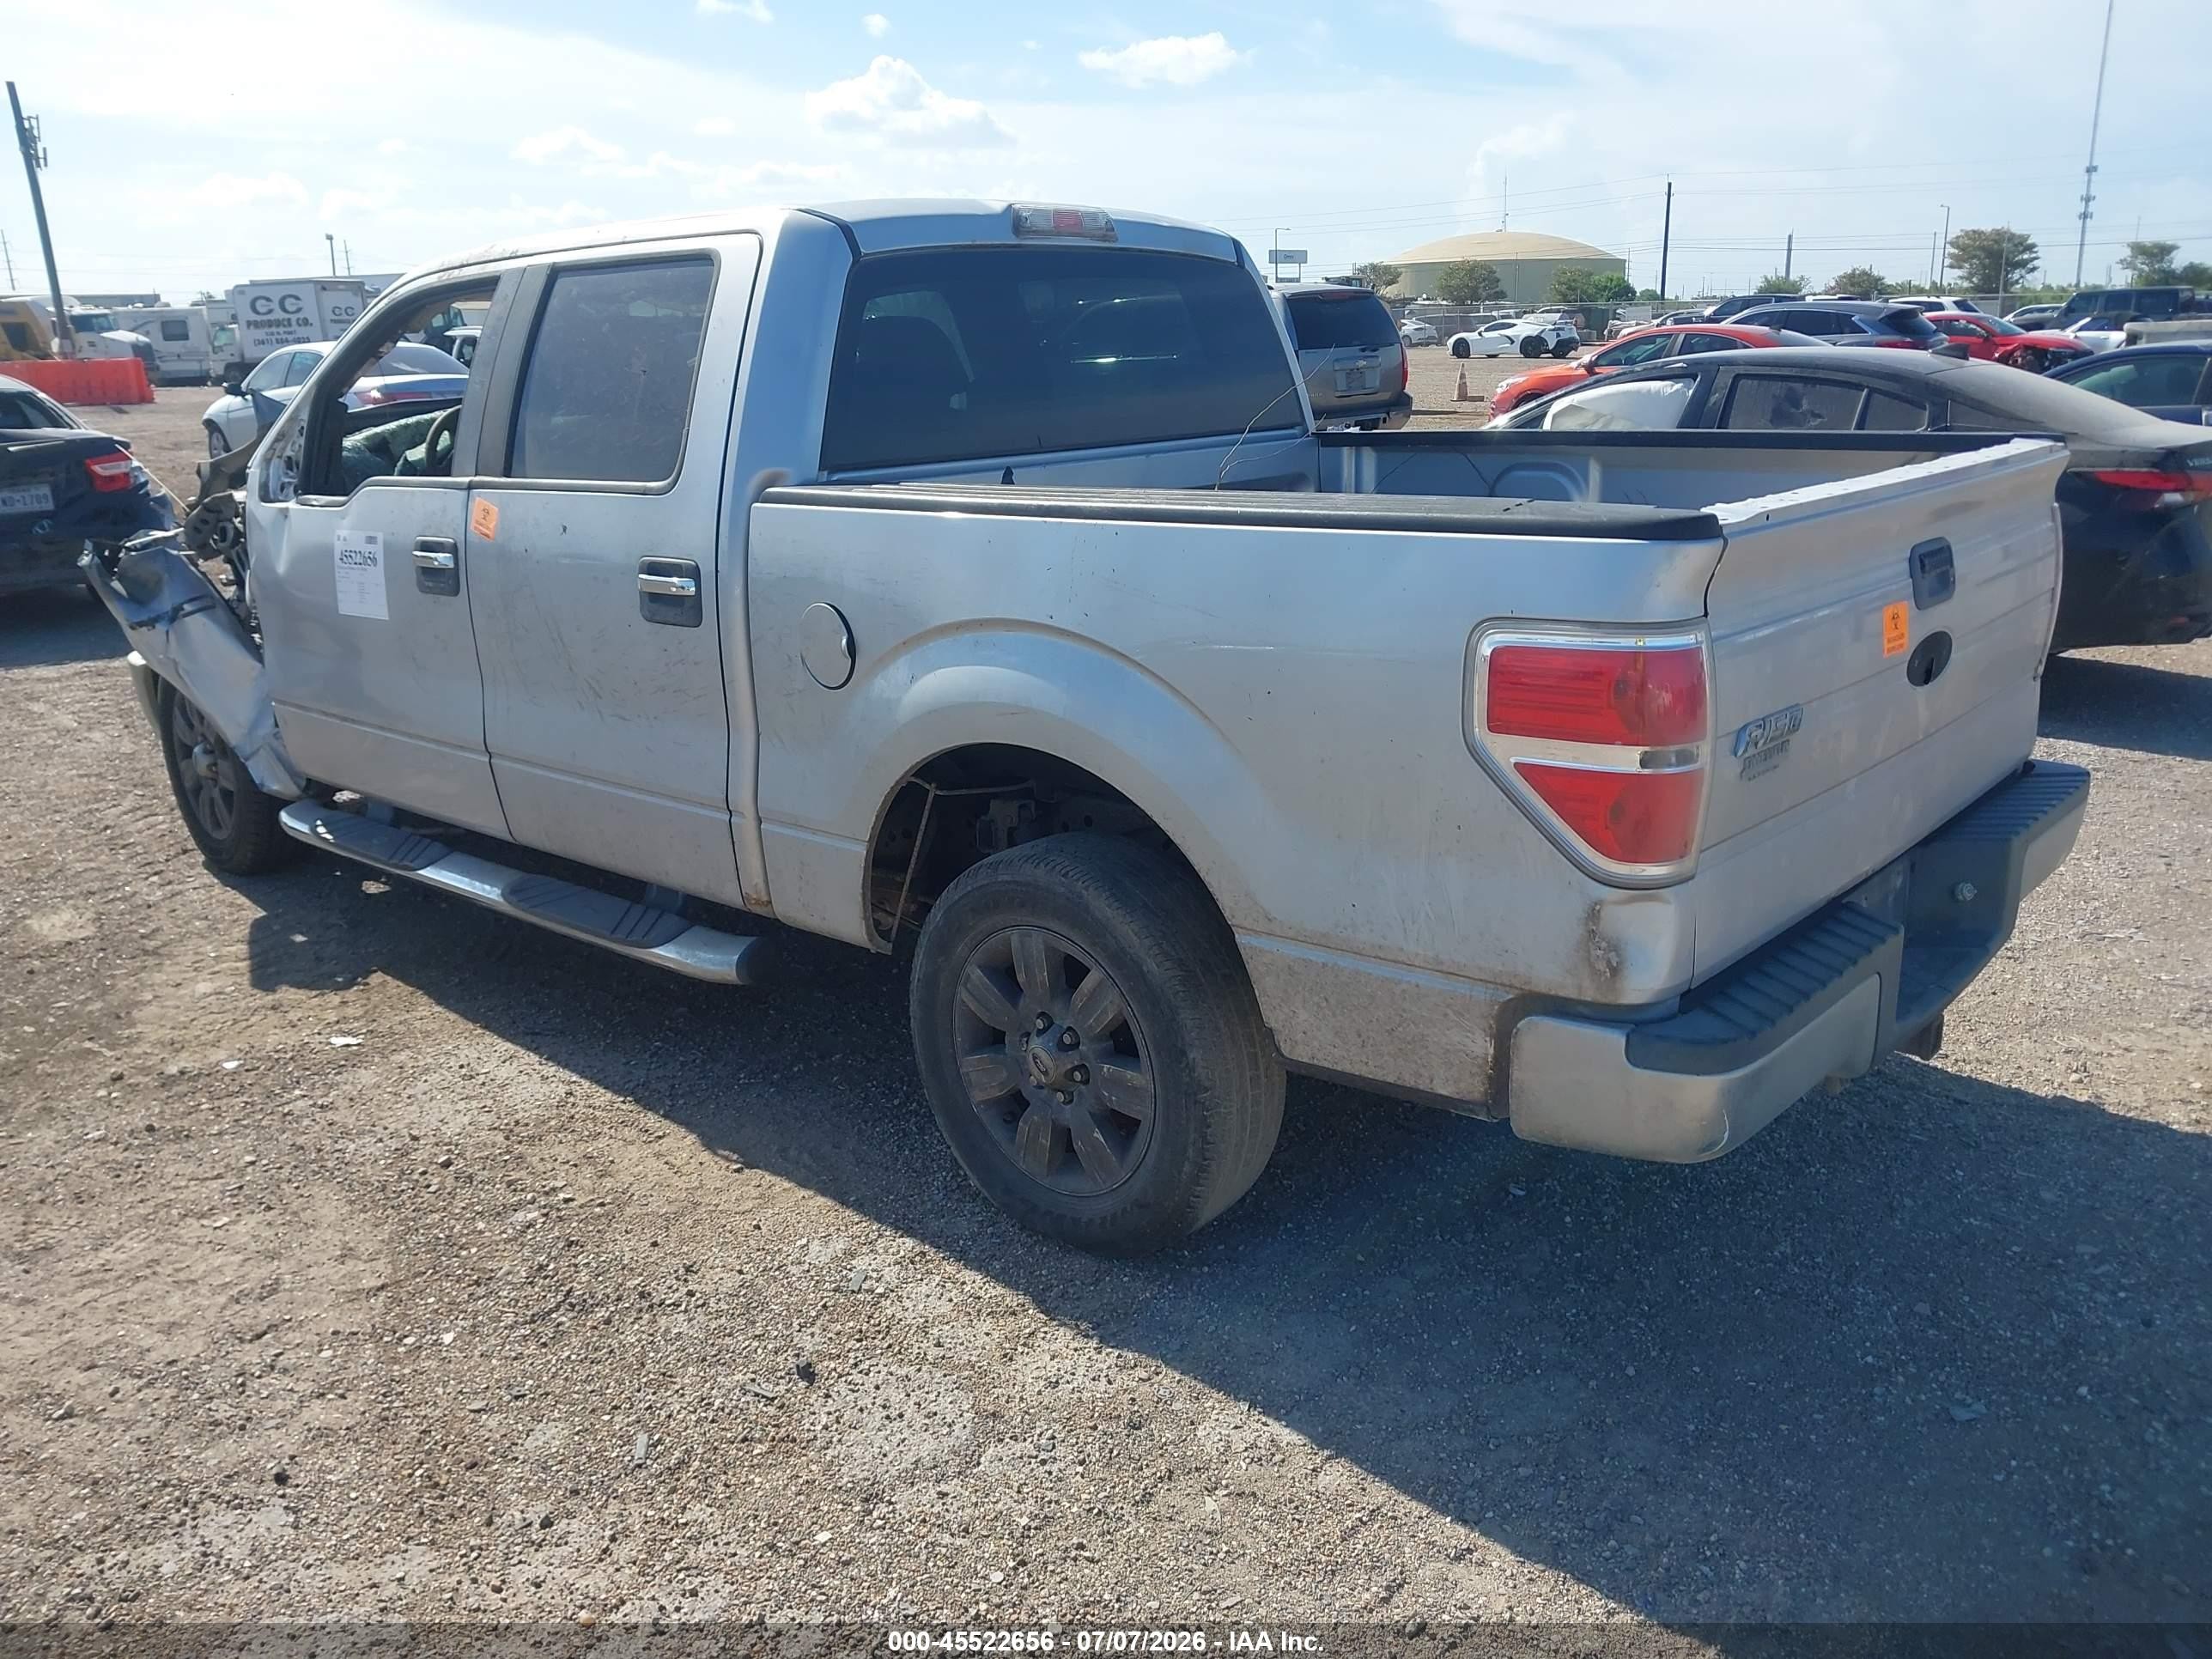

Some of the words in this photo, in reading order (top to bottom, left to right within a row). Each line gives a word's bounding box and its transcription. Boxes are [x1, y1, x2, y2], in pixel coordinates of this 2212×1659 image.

[246, 318, 292, 330] PRODUCE
[295, 316, 313, 327] CO.
[338, 549, 379, 568] 45522656
